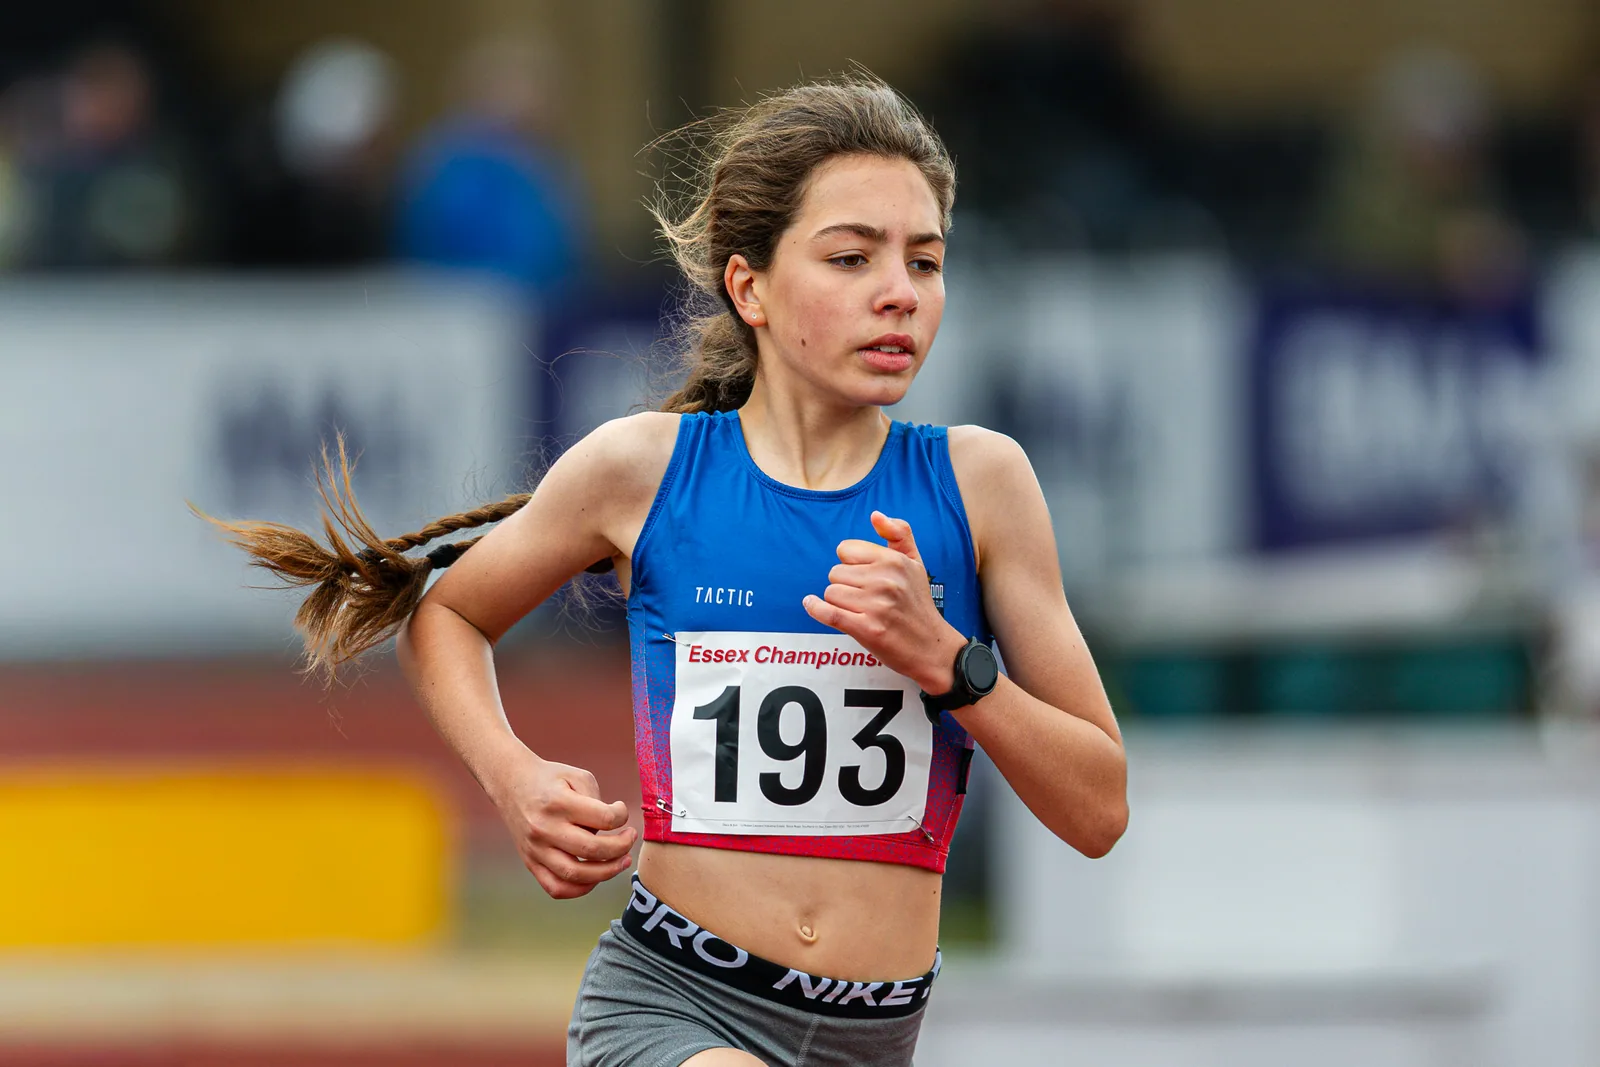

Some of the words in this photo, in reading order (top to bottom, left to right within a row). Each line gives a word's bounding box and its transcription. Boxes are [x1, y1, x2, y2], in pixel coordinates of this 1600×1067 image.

[695, 586, 754, 607] TACTIC
[688, 645, 748, 663] Essex
[754, 646, 882, 669] Champions
[693, 686, 906, 807] 193
[626, 880, 748, 969] PRO
[773, 968, 923, 1006] NIKE
